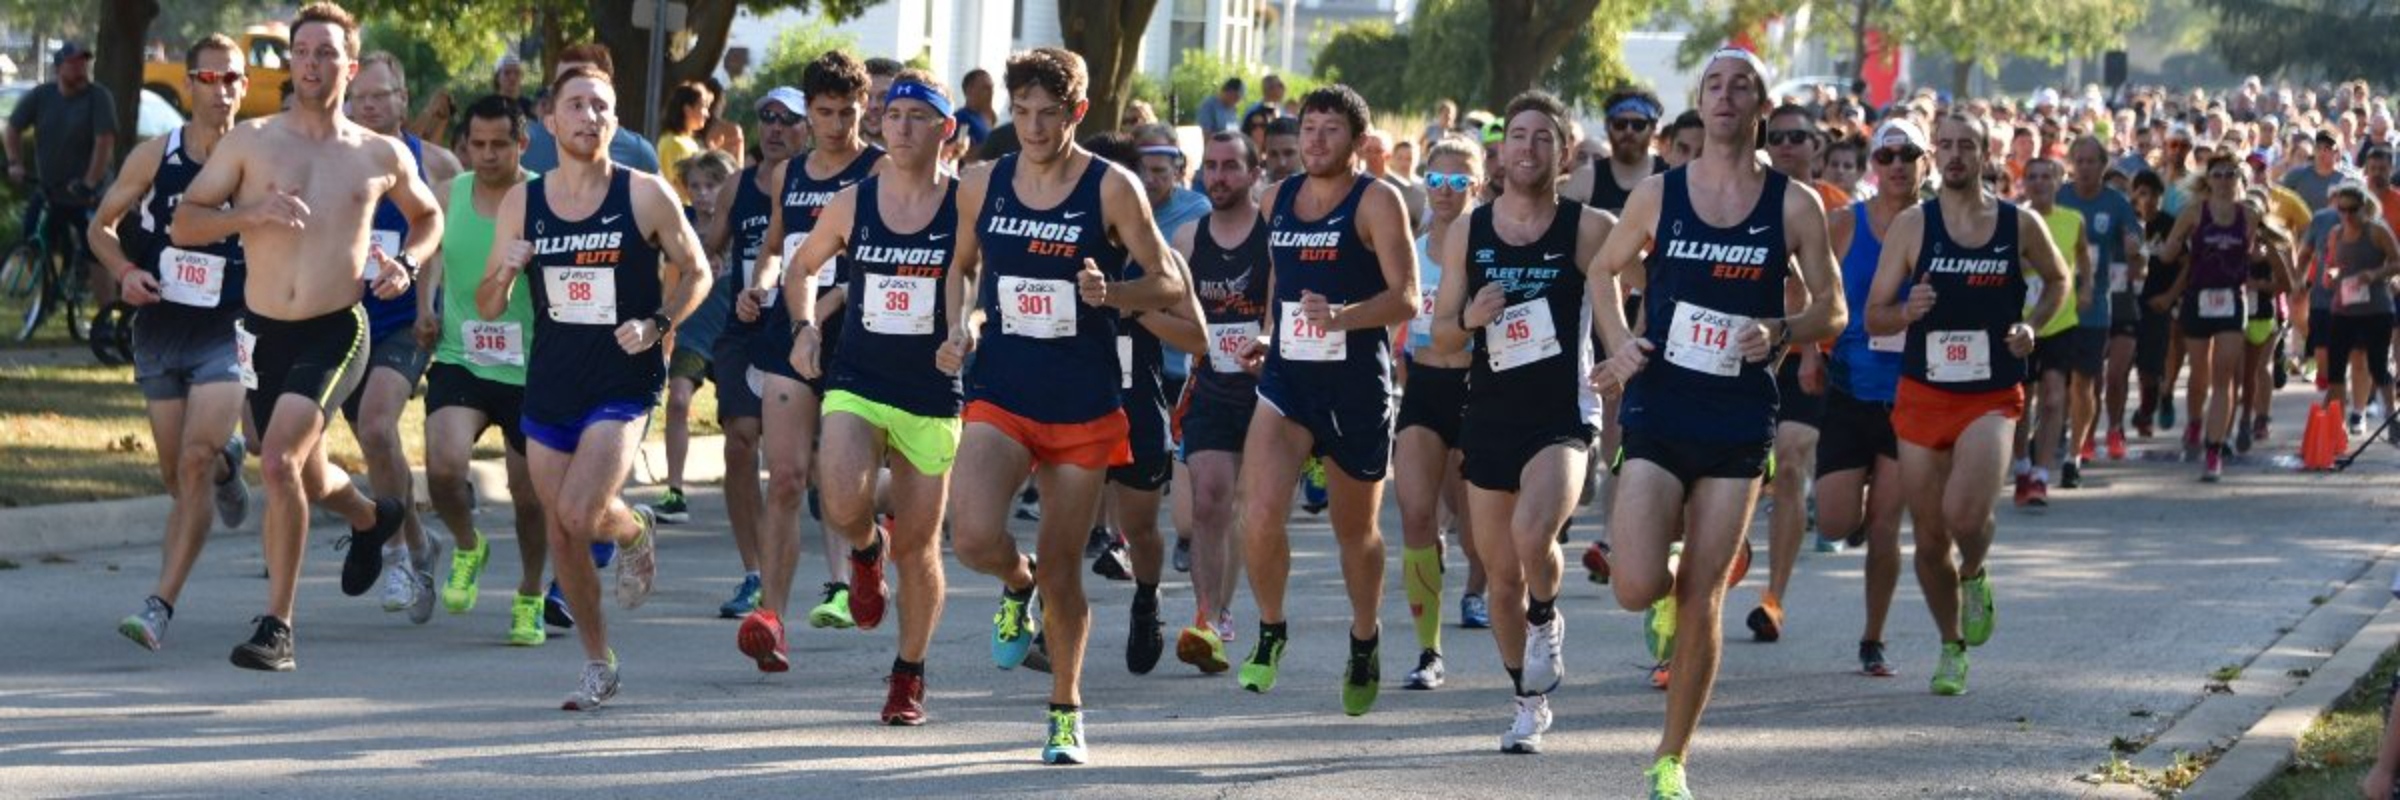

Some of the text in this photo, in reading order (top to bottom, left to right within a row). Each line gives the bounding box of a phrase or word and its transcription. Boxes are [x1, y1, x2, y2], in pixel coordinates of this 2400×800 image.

[785, 191, 836, 207] ILLINO
[987, 215, 1083, 243] ILLINOIS
[534, 231, 623, 255] ILLINOIS
[1270, 231, 1340, 247] ILLINOIS
[575, 249, 621, 265] ELITE
[855, 245, 946, 265] ILLINOIS
[1027, 240, 1077, 258] ELITE
[1300, 249, 1339, 261] ELITE
[1666, 239, 1769, 265] ILLINOIS
[896, 265, 943, 277] ELITE
[1485, 267, 1560, 279] FLEET FEET
[1712, 264, 1763, 280] ELITE
[1929, 257, 2009, 275] ILLINOIS
[568, 281, 592, 301] 88
[885, 291, 909, 311] 39
[1017, 293, 1052, 315] 301
[1506, 319, 1530, 342] 45
[1691, 322, 1728, 350] 114
[475, 334, 506, 351] 316
[1219, 335, 1248, 353] 45
[1946, 344, 1968, 361] 89
